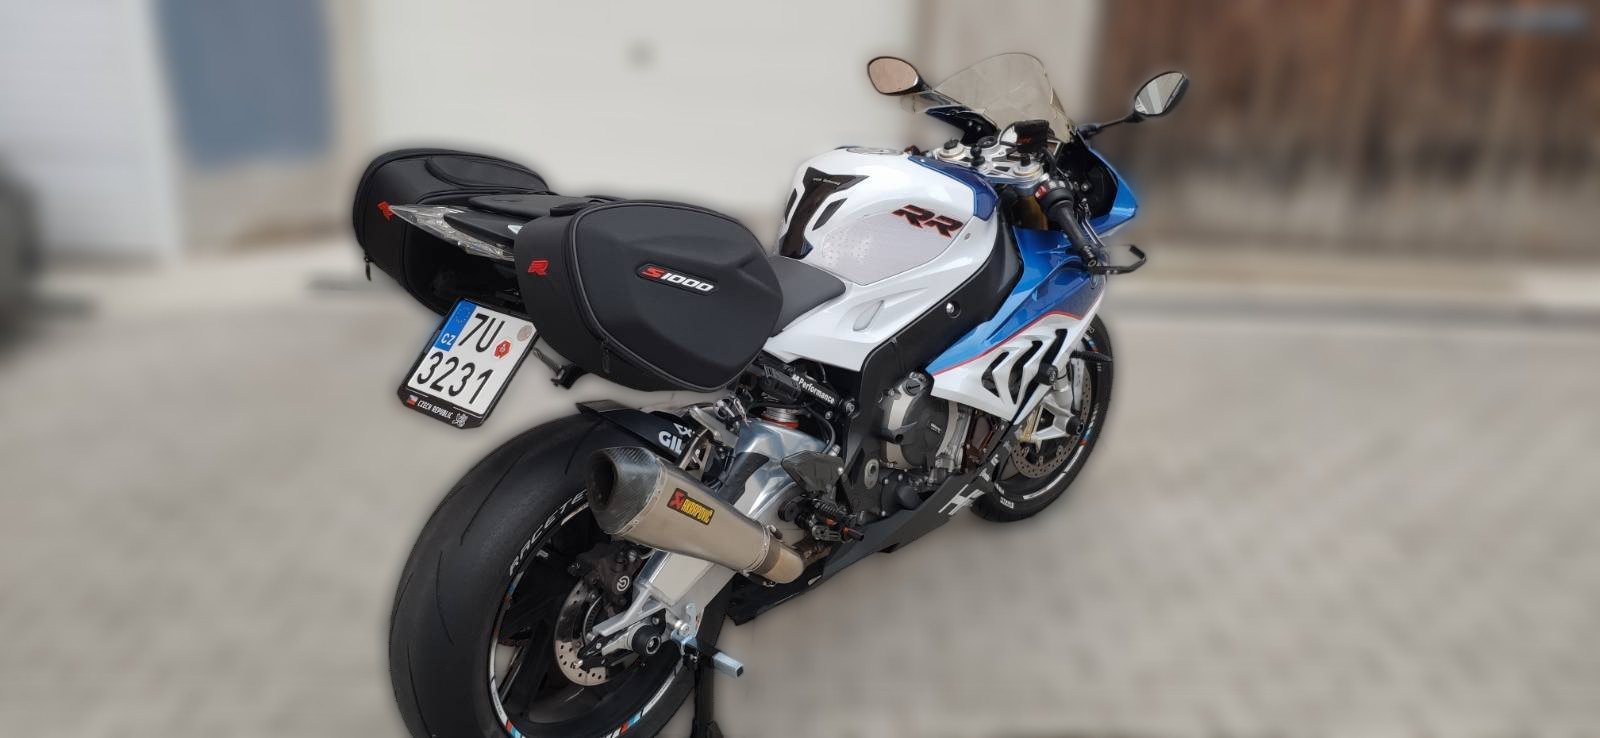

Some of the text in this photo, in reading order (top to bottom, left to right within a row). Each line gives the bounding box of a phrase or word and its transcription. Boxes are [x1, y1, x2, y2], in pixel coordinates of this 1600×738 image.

[891, 204, 964, 238] RR
[641, 266, 714, 291] S1000
[441, 333, 456, 346] CZ
[458, 313, 506, 353] 7U
[417, 351, 494, 405] 3231
[799, 378, 835, 404] Performance
[417, 400, 454, 419] CZECH REPUBLIC
